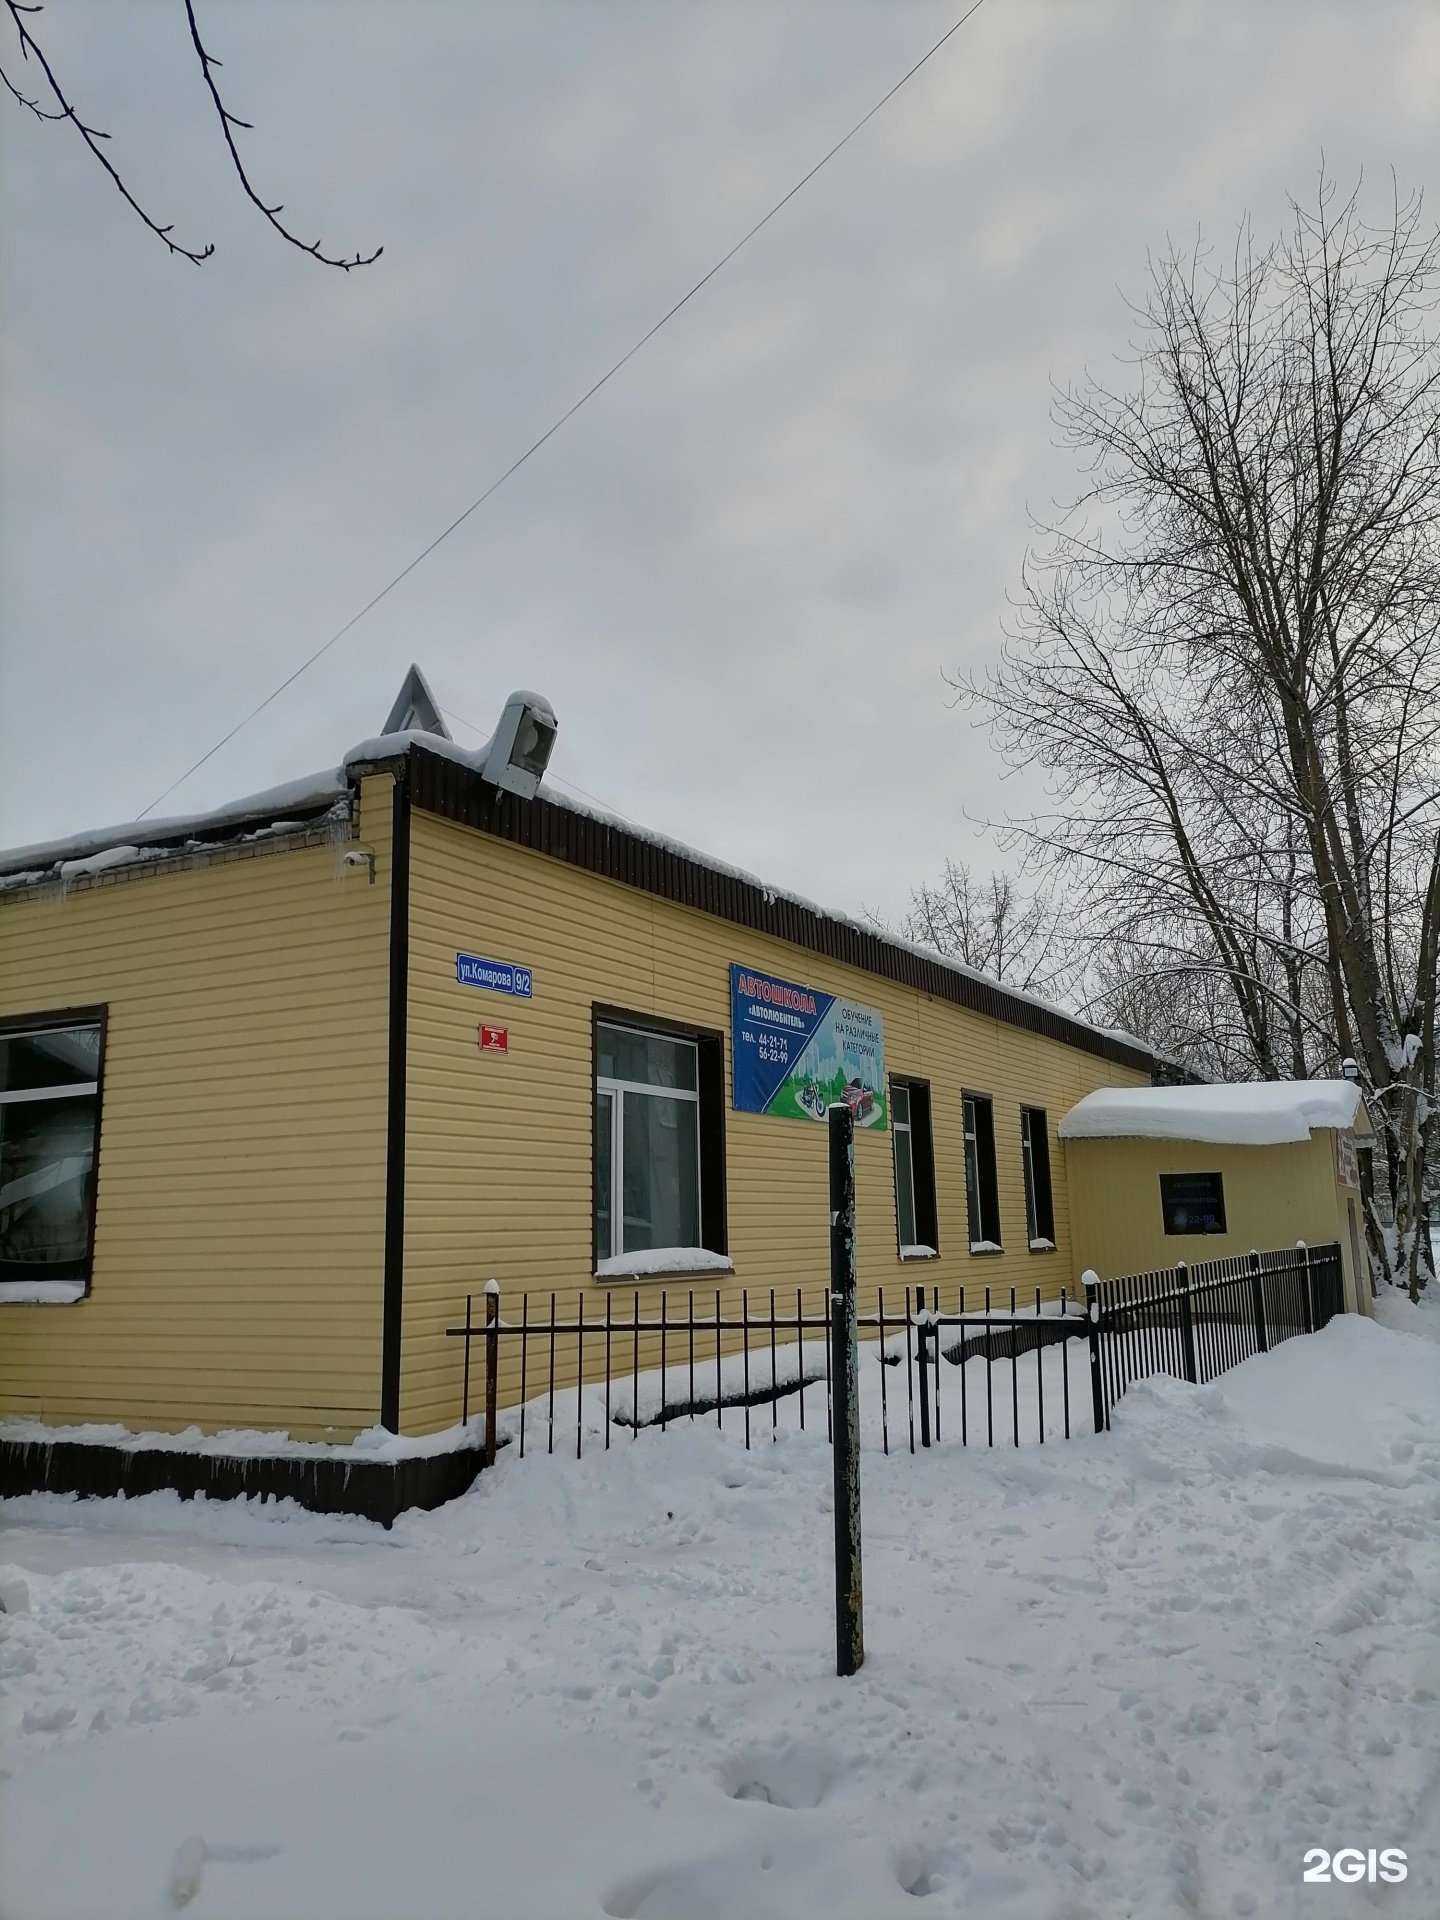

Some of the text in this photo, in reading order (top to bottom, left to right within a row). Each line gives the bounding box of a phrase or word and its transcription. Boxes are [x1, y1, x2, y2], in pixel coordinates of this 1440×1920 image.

[461, 963, 530, 992] ул.Комарова 9/2
[738, 974, 817, 1016] АВТОШКОЛА
[841, 1008, 873, 1027] ОБУЧЕНИЕ
[742, 1031, 788, 1050] тел. 44-21-71
[835, 1022, 880, 1044] НА РАЗЛИЧНЫЕ
[758, 1047, 788, 1064] 56-22-99
[842, 1040, 875, 1057] КАТЕГОРИИ
